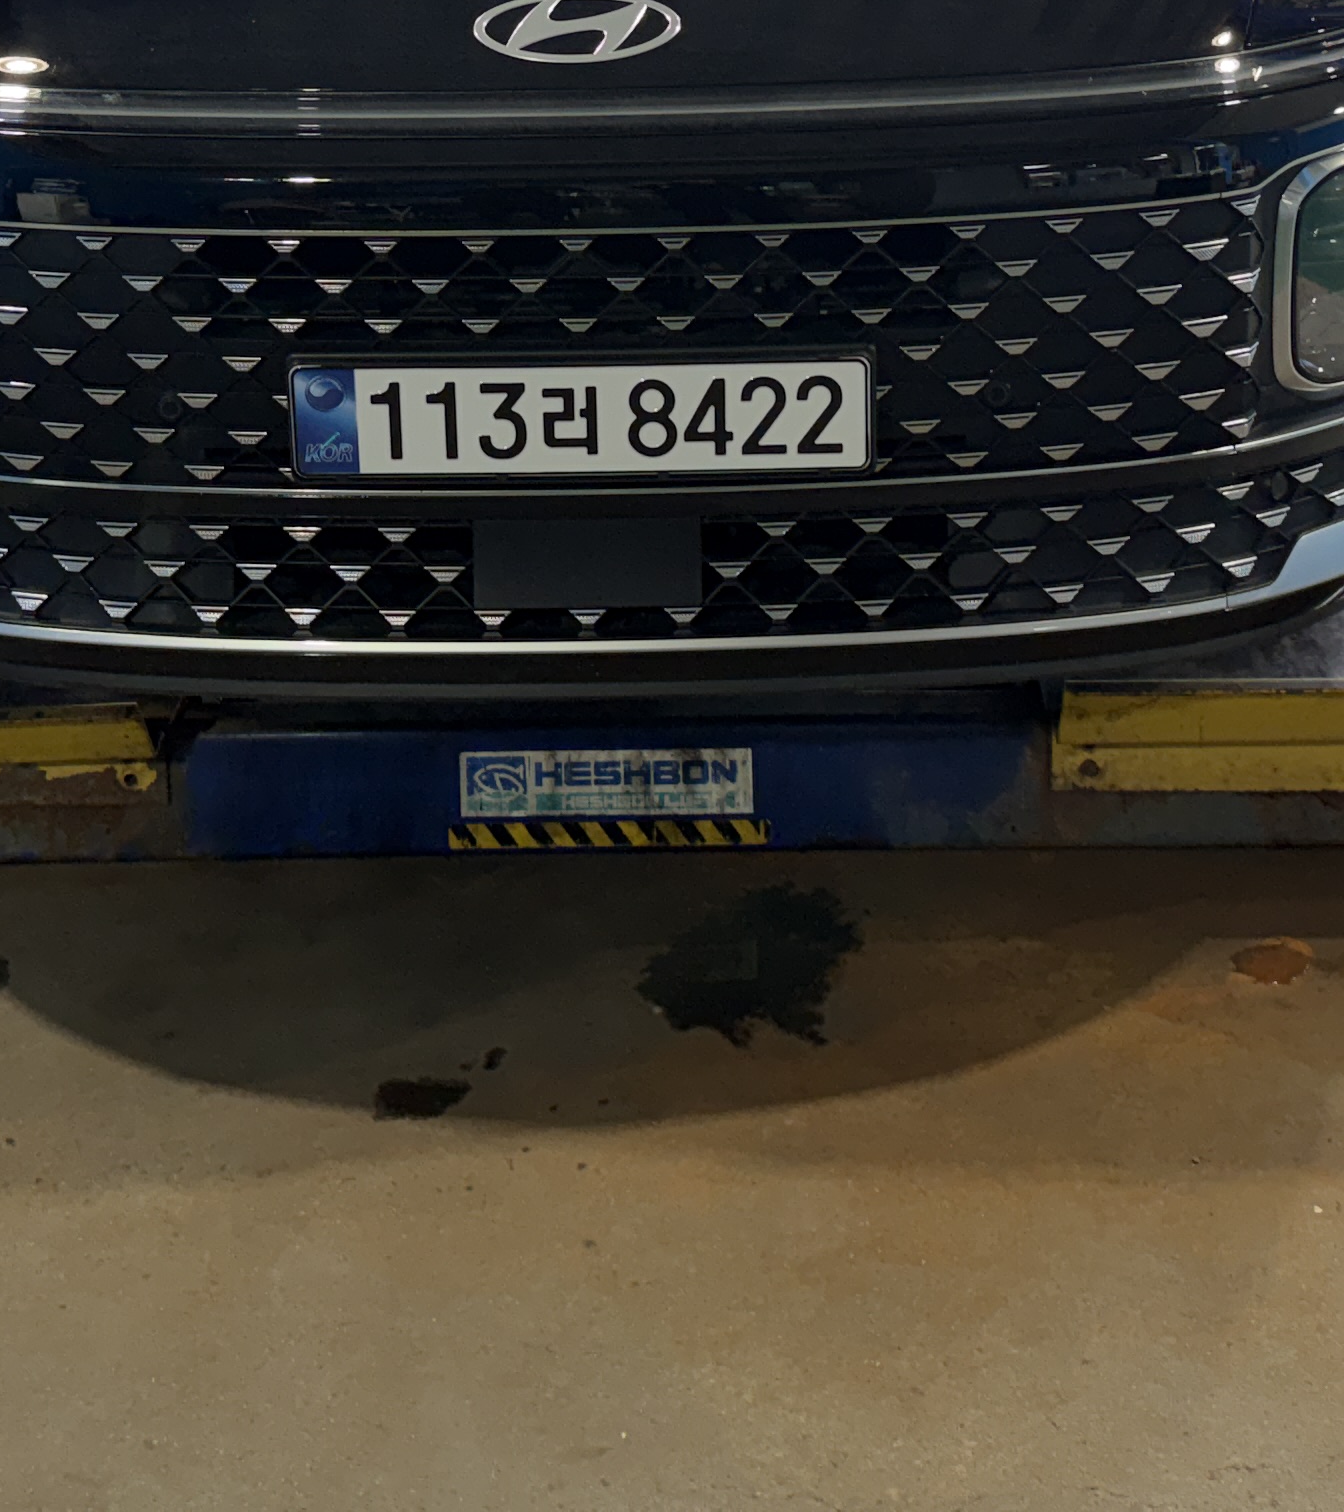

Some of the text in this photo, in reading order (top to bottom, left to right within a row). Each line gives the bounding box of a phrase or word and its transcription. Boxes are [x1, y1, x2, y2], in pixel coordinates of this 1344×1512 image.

[369, 376, 844, 460] 113러 8422
[304, 442, 354, 463] KOR
[534, 759, 738, 787] HESHBON
